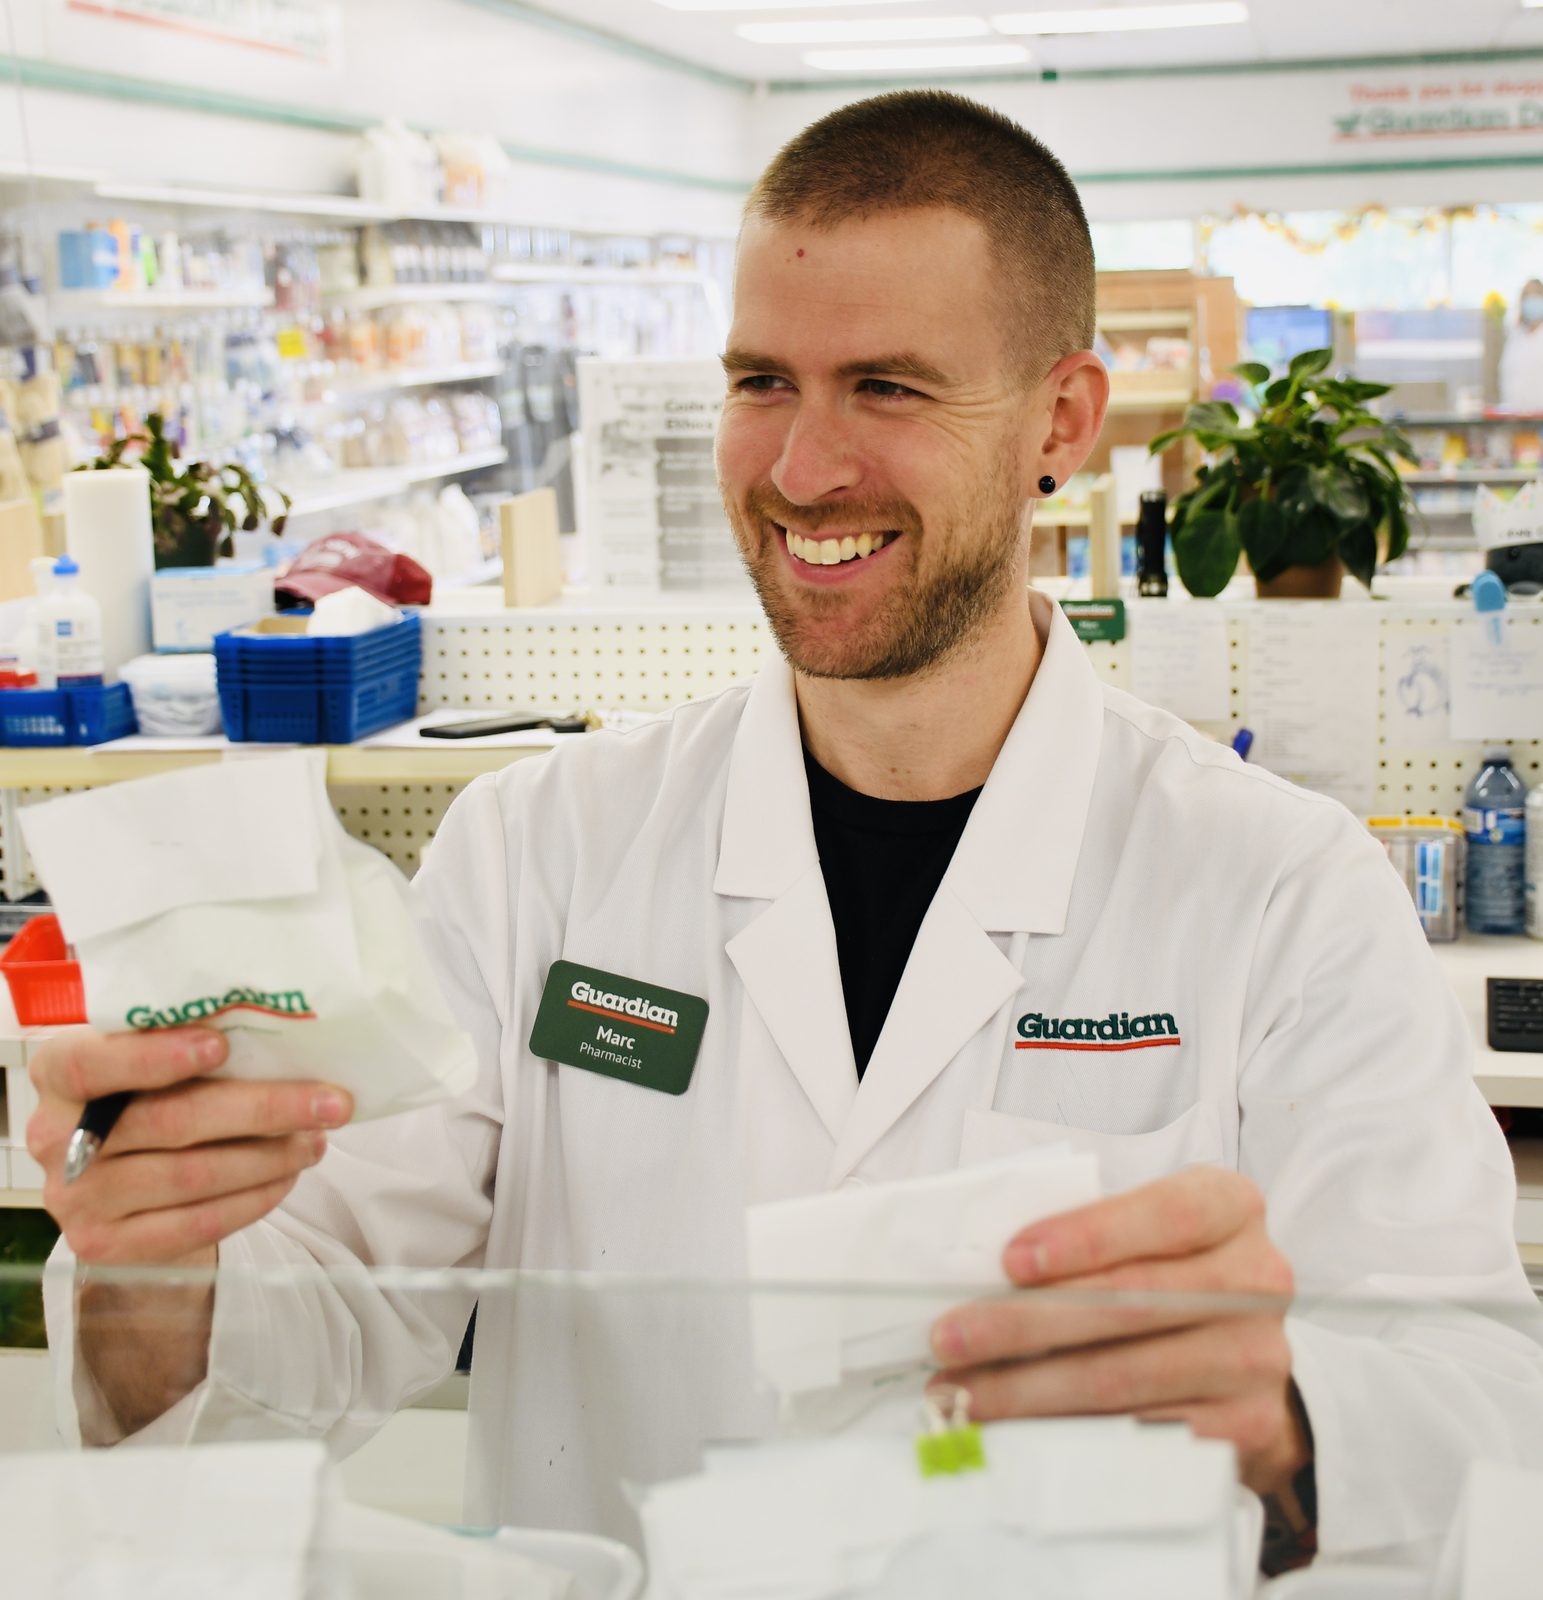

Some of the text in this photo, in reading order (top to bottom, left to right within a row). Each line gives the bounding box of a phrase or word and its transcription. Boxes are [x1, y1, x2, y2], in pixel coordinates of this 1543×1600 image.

[1367, 105, 1509, 132] Guardian
[571, 981, 679, 1027] Guardian
[595, 1026, 637, 1051] Marc
[1016, 1012, 1179, 1040] Guardian
[579, 1041, 644, 1071] Pharmacist
